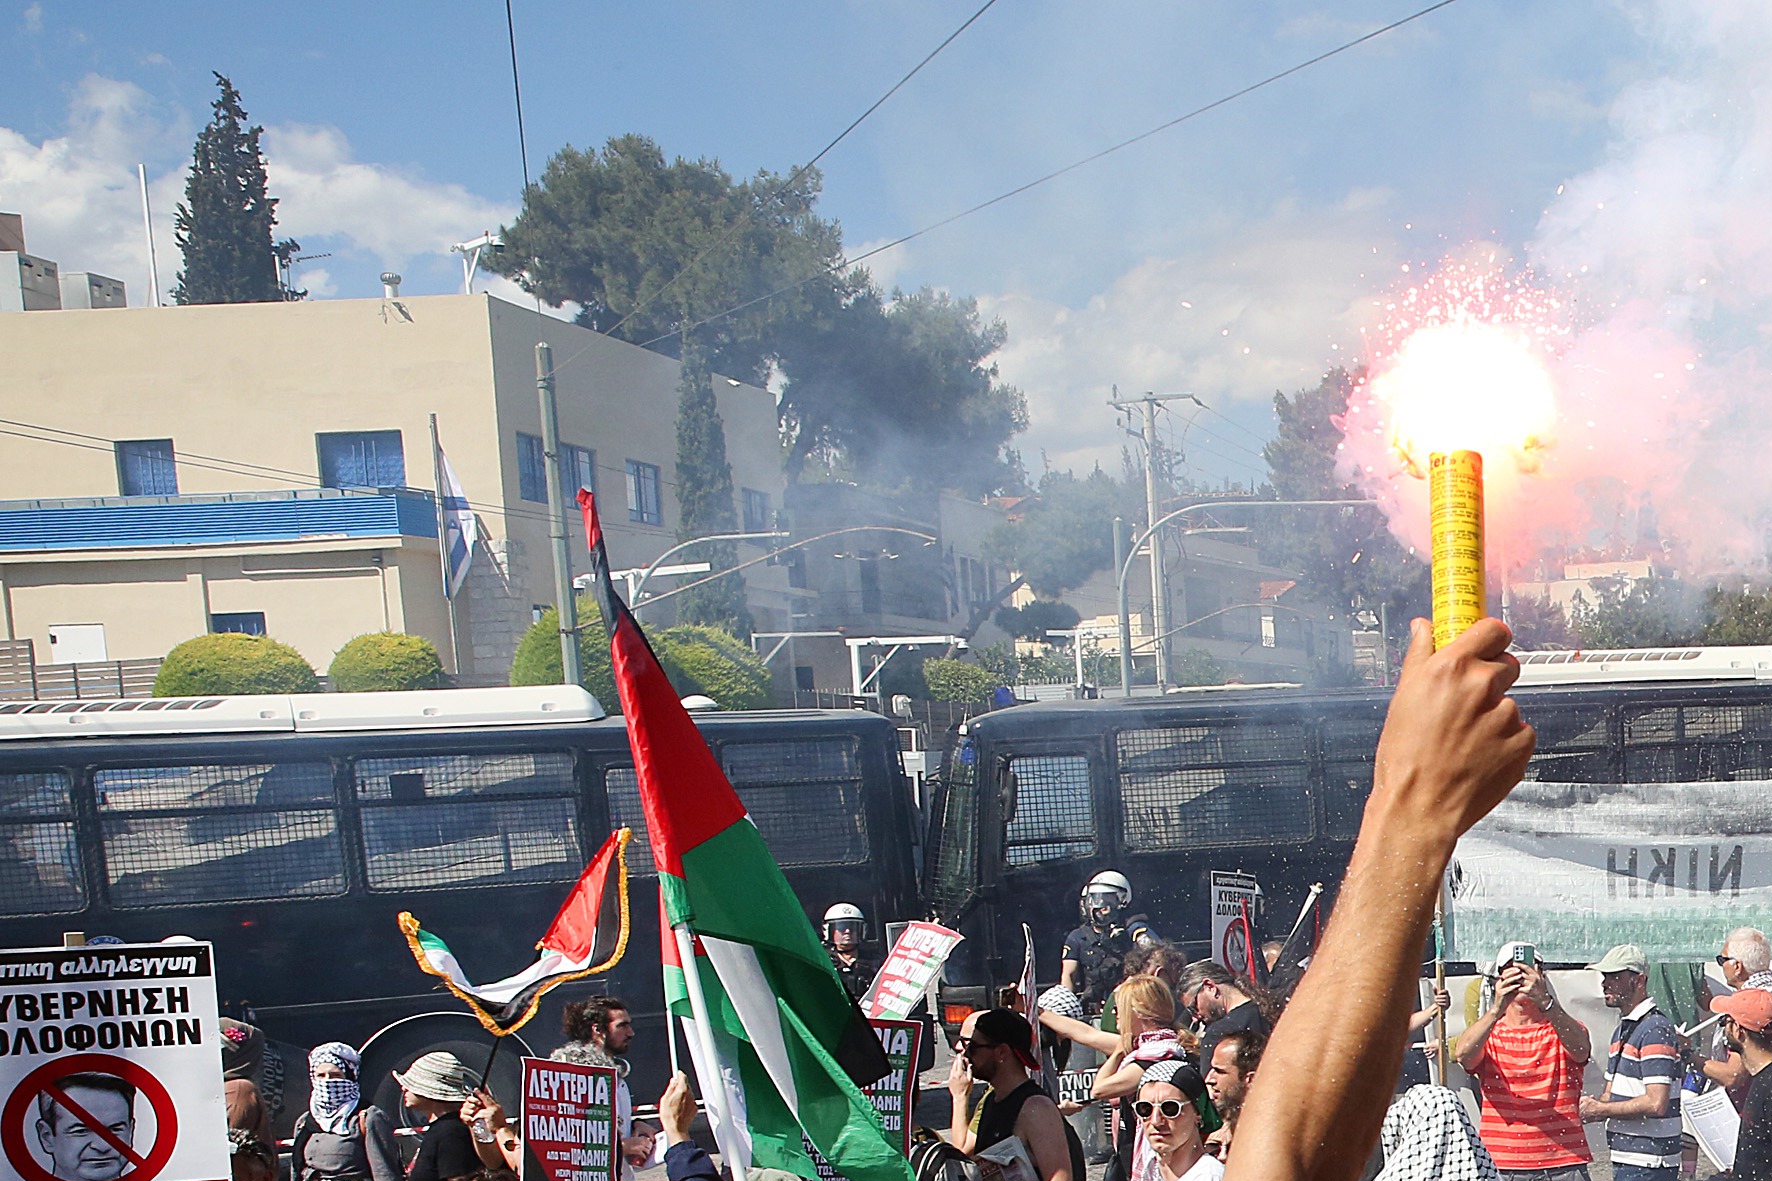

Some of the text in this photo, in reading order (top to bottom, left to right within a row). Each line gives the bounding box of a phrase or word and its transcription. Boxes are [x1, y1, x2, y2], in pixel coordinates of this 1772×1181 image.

[60, 955, 197, 977] αλληλεγγυη
[529, 1068, 609, 1105] ΛΕΥΤΕΡΙΑ
[529, 1115, 609, 1145] ΠΑΛΑΙΣΤΙΝΗ
[571, 1148, 608, 1167] ΙΟΡΔΑΝΗ
